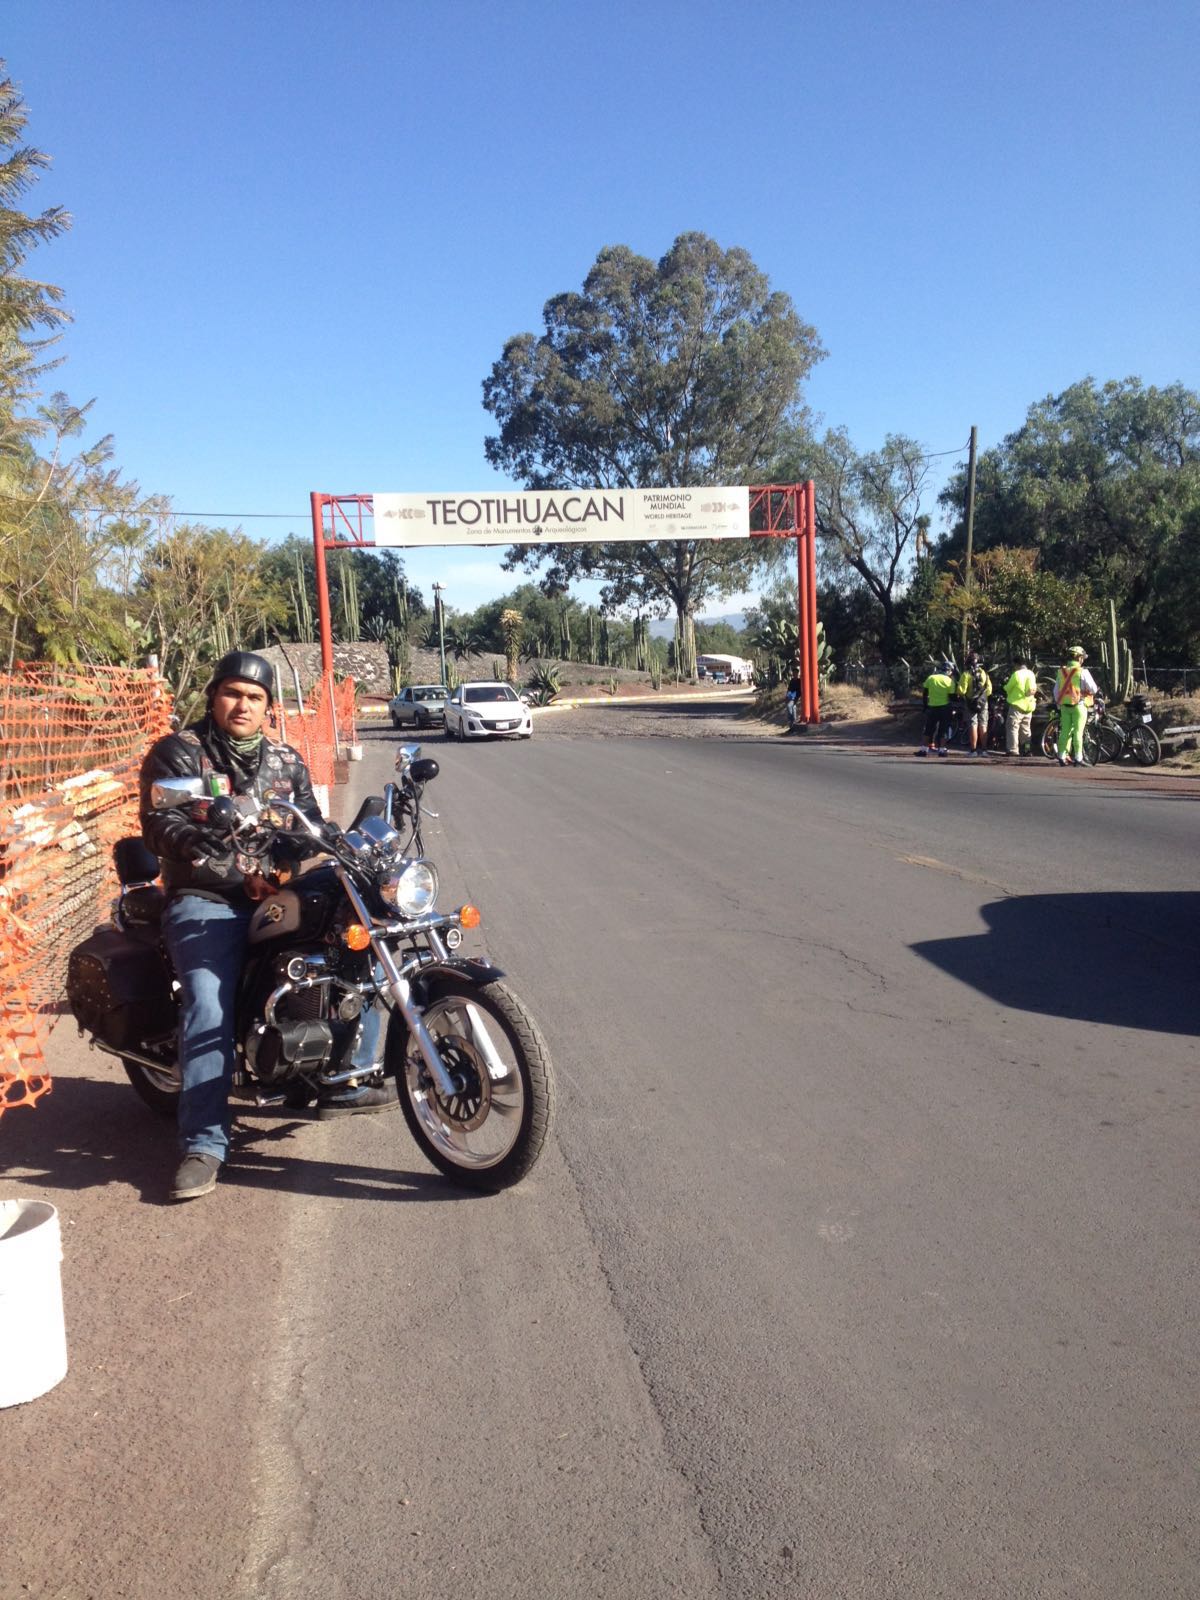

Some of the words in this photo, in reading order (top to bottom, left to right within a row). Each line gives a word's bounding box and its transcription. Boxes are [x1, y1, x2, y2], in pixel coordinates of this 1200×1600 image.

[643, 494, 692, 502] PATRIMONIO
[650, 502, 686, 510] MUNDIAL
[426, 496, 625, 525] TEOTIHUACAN
[466, 527, 482, 535] Zona
[483, 527, 492, 535] de
